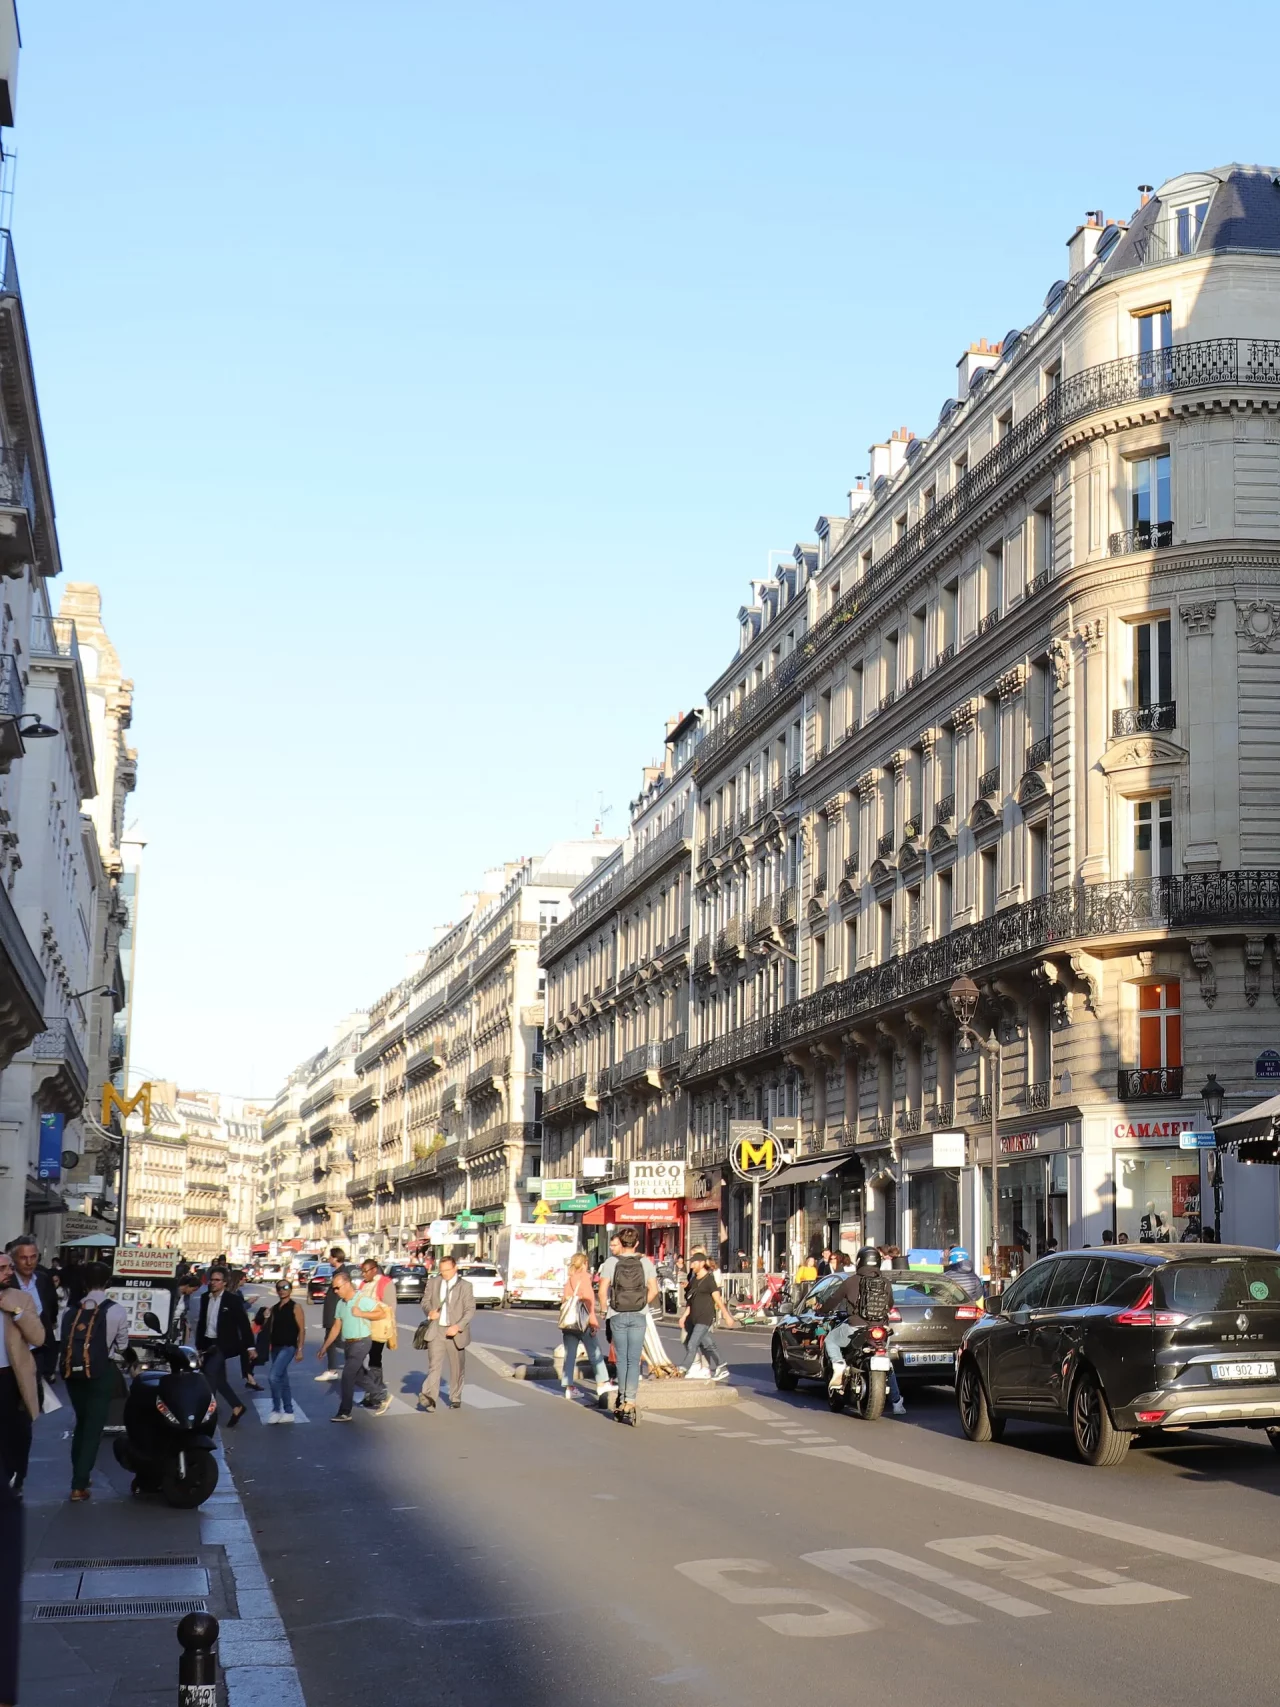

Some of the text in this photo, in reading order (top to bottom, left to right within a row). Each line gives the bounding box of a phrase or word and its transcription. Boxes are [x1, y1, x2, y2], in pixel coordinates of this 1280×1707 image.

[103, 1082, 151, 1126] M
[741, 1139, 773, 1171] M
[634, 1162, 681, 1181] méo
[116, 1259, 134, 1267] PLATS
[117, 1250, 174, 1259] RESTAURANT
